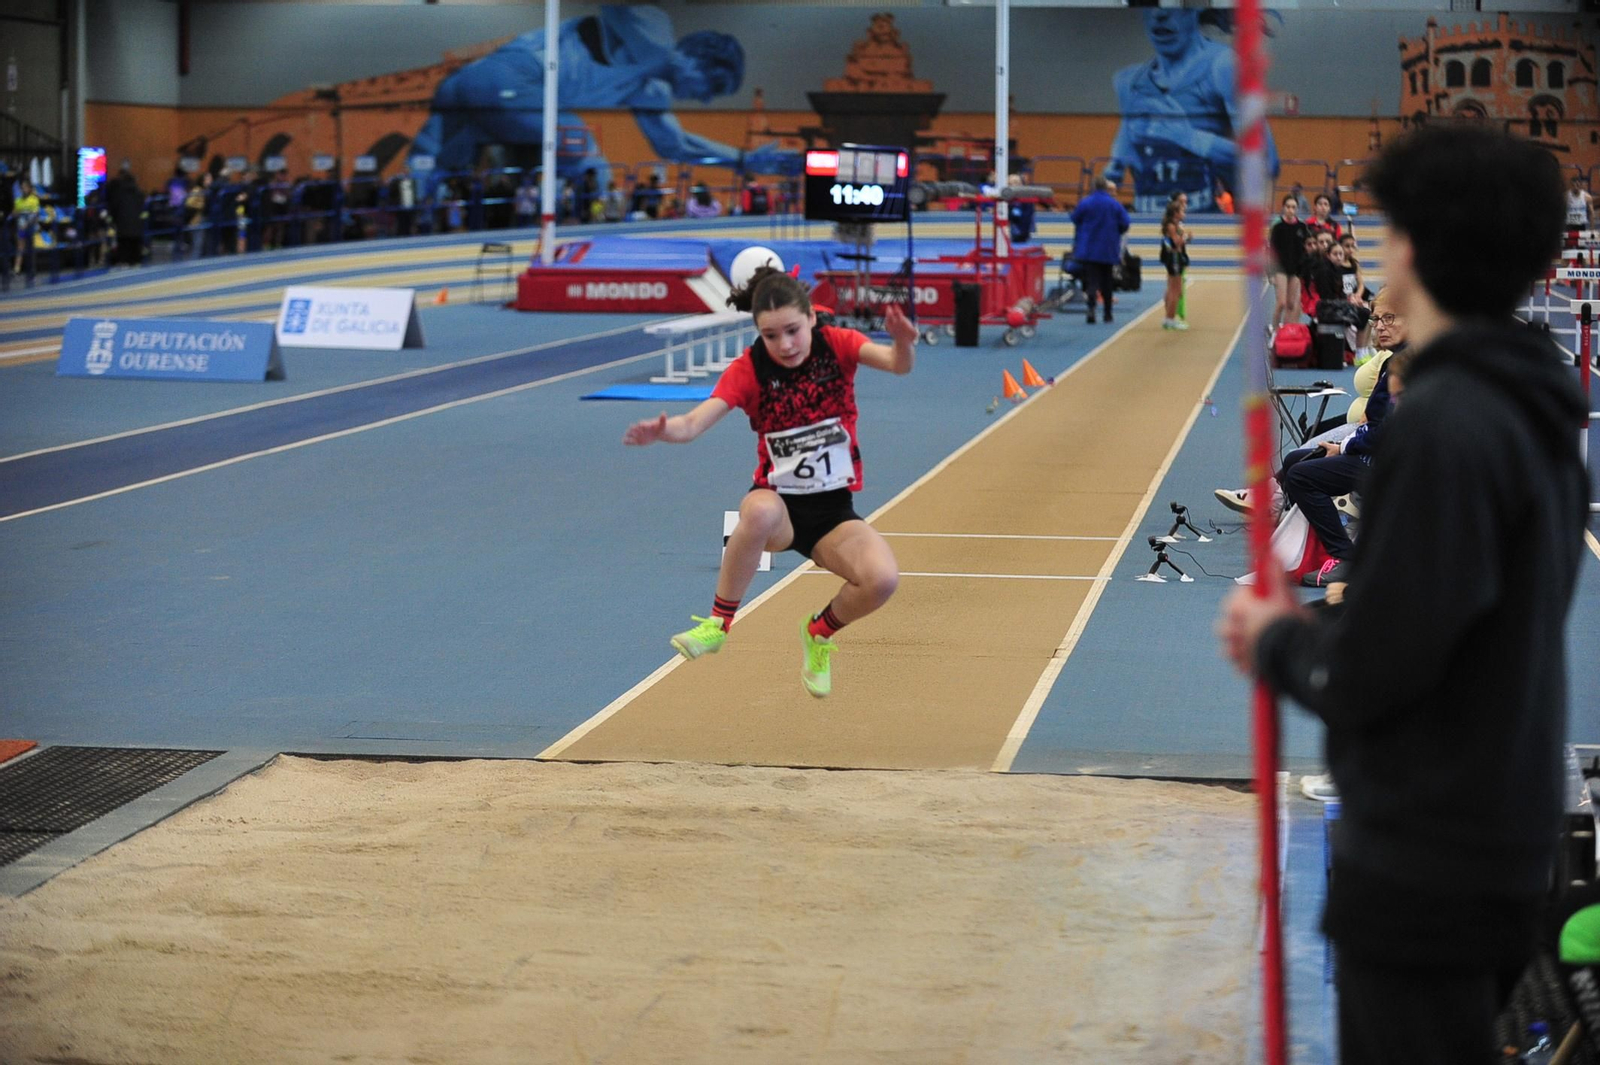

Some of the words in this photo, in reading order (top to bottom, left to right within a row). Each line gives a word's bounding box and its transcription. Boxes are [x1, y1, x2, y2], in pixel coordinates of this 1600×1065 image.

[1154, 159, 1180, 183] 17
[830, 184, 884, 206] 11:40
[586, 282, 668, 300] MONDO
[316, 301, 370, 317] XUNTA
[311, 318, 332, 333] DE
[337, 318, 399, 335] GALICIA
[123, 330, 247, 352] DEPUTACIÓN
[119, 352, 209, 373] OURENSE
[793, 451, 831, 479] 61
